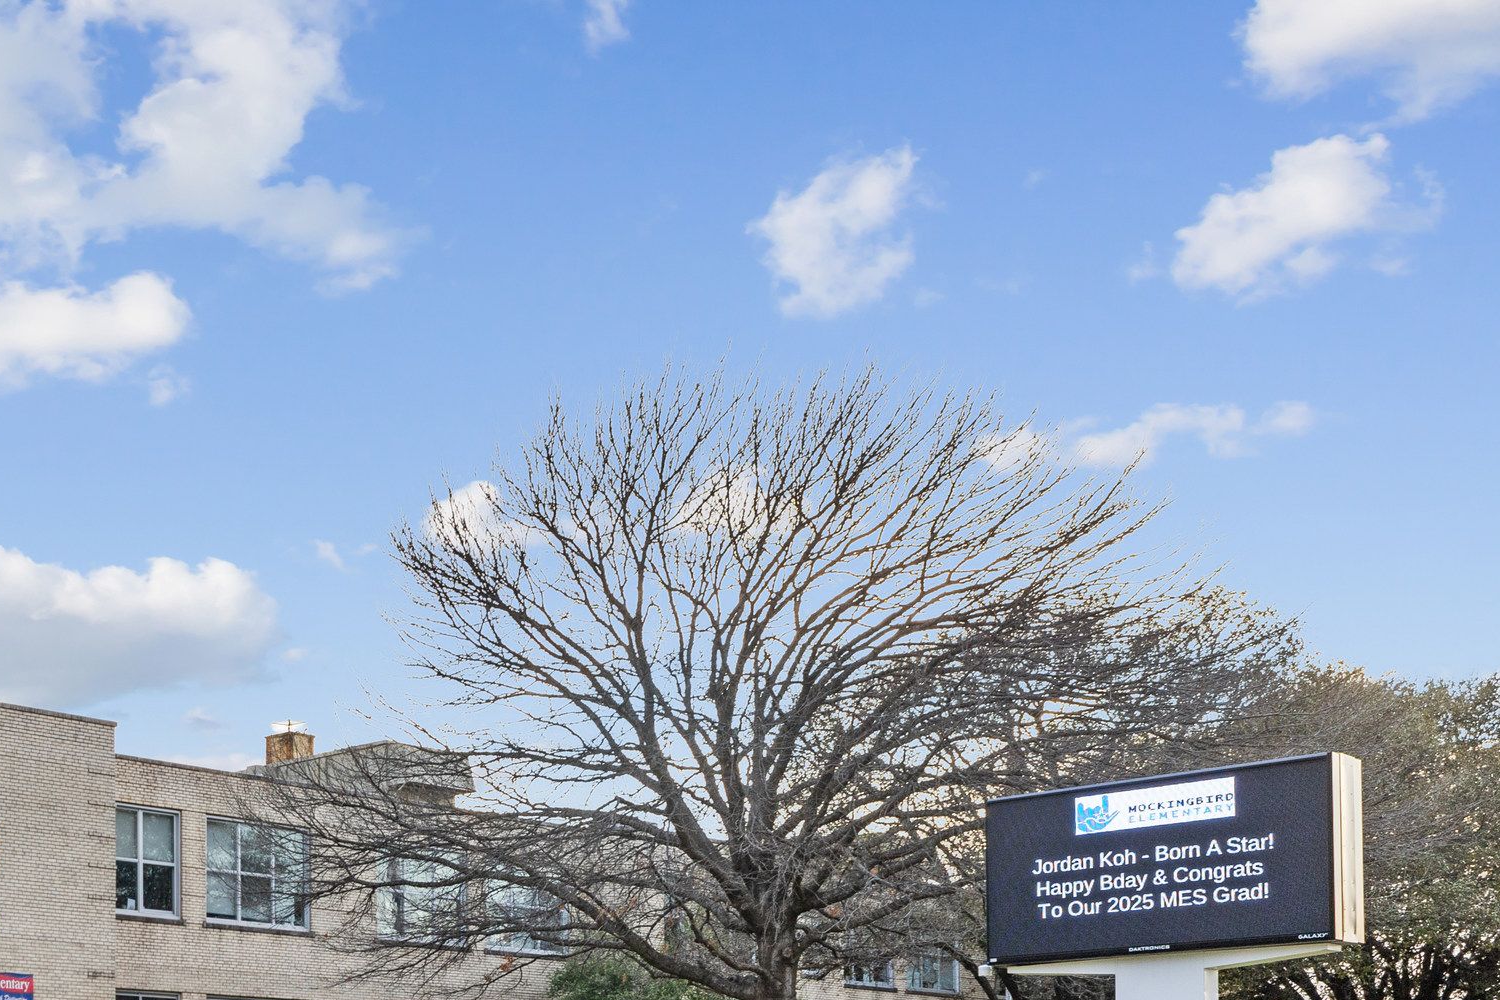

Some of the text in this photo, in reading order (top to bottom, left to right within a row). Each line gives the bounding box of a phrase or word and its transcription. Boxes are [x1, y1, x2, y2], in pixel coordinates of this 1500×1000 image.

[1128, 792, 1234, 813] MOCKINGBIRD
[1128, 802, 1234, 824] ELEMENTARY
[1032, 856, 1094, 875] Jordan
[1099, 849, 1136, 868] Koh
[1155, 844, 1201, 862] Born
[1206, 839, 1222, 856] A
[1226, 832, 1275, 854] Star!
[1036, 859, 1264, 899] Happy Bday & Congrats
[1037, 882, 1270, 919] To Our 2025 MES Grad!
[1297, 932, 1329, 940] GALAXY
[1128, 944, 1171, 952] DAKTRONICS
